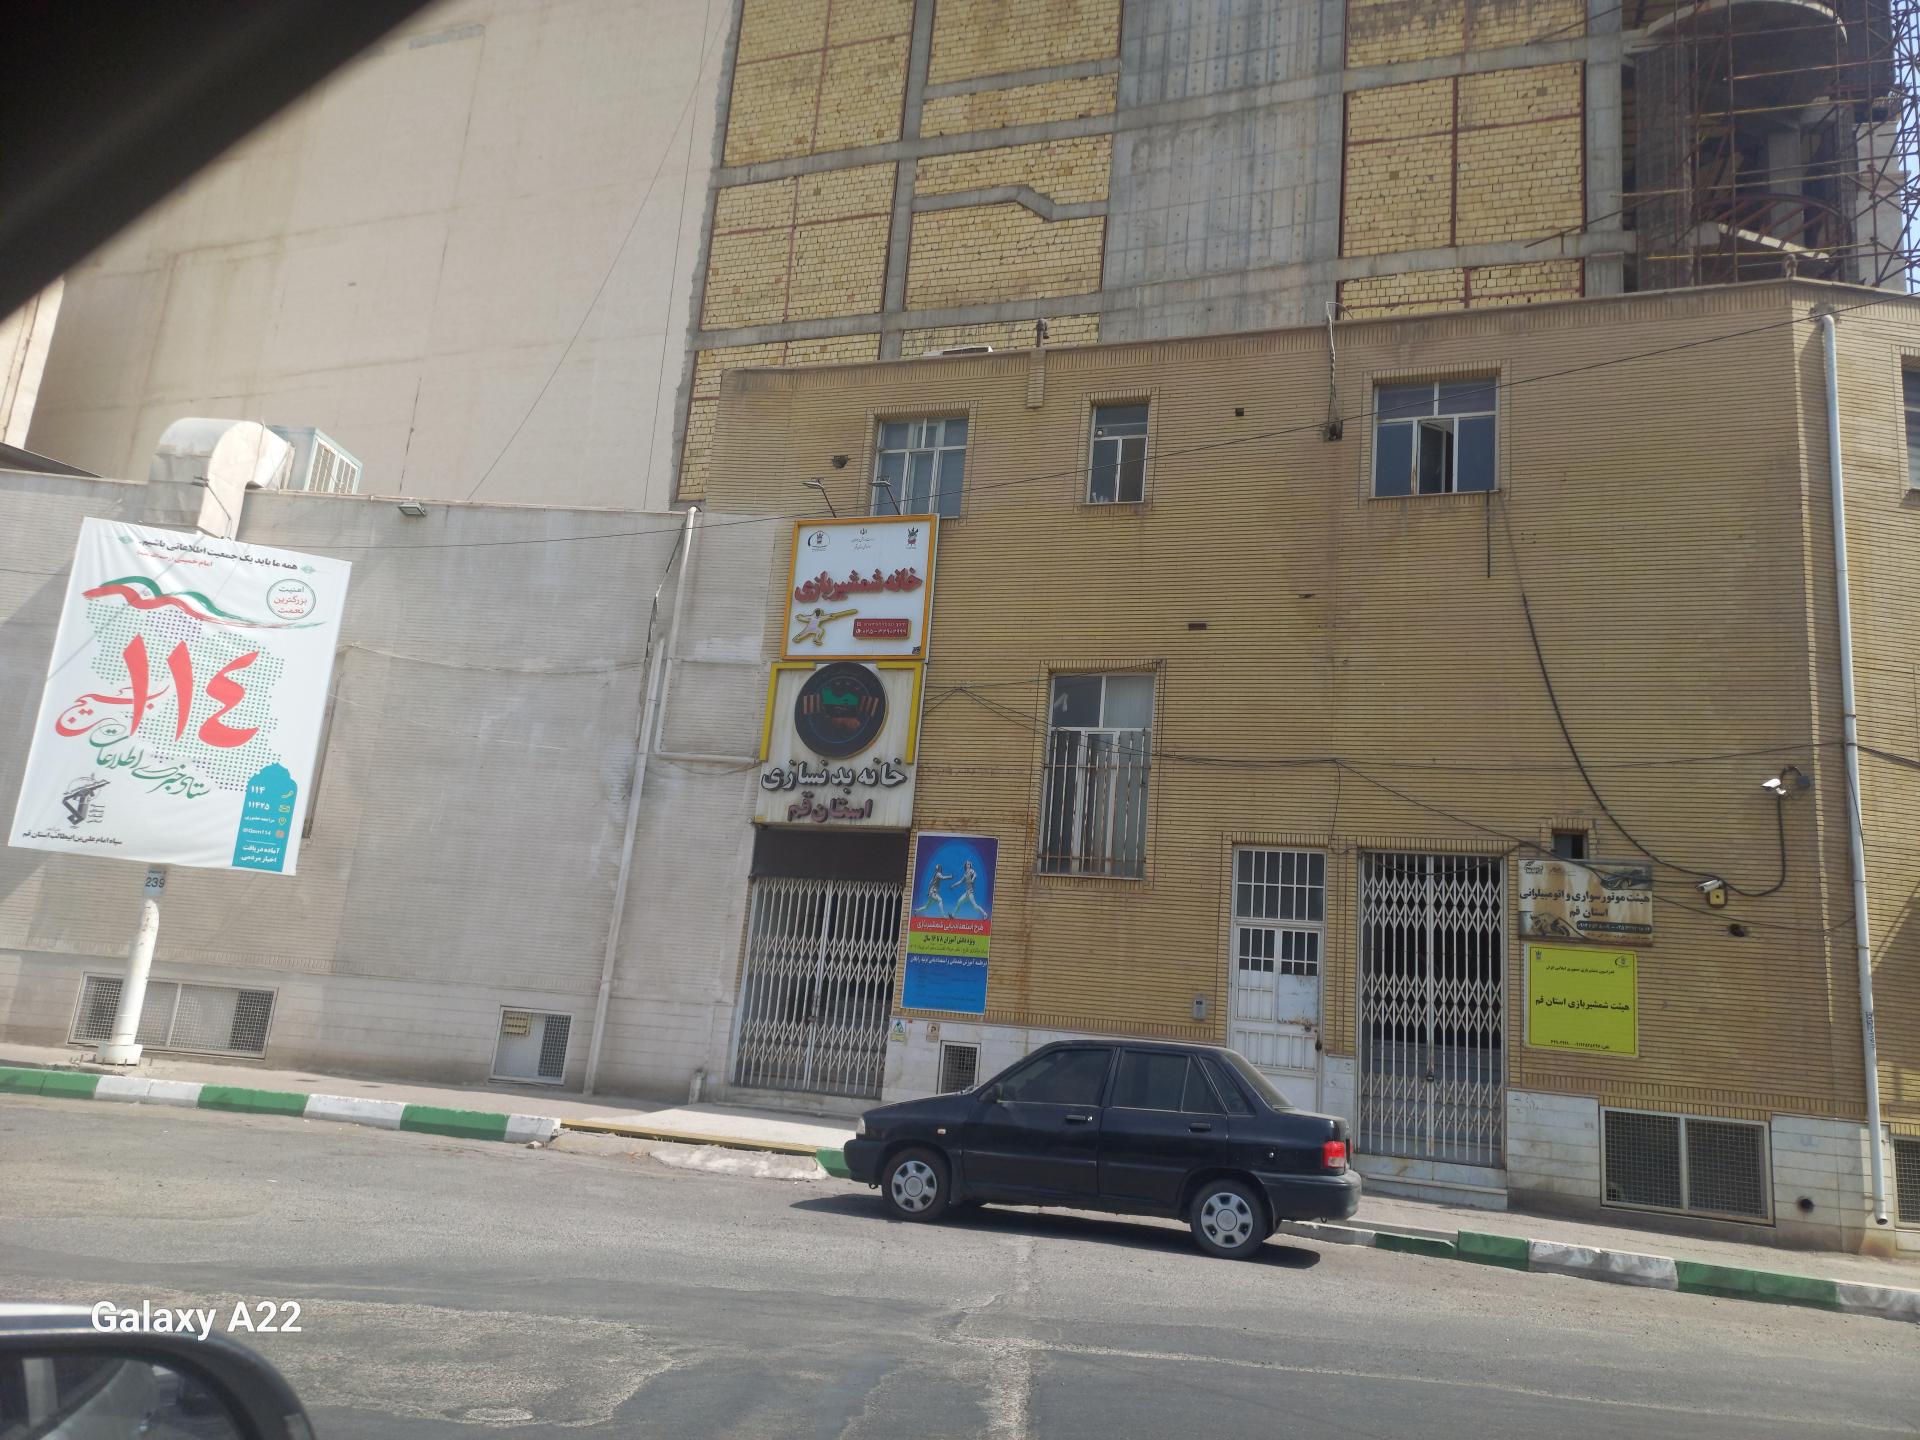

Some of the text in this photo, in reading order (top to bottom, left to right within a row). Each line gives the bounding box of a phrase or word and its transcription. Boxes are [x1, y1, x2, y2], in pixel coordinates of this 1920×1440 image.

[167, 542, 206, 554] اطلاعاتی
[207, 548, 237, 560] جمعیت
[883, 567, 924, 592] خانه
[856, 757, 908, 787] خانه
[787, 791, 874, 823] استان قم
[145, 877, 166, 888] 239
[1569, 905, 1609, 919] استان قم
[1535, 995, 1545, 1006] قم
[1545, 996, 1567, 1006] استان
